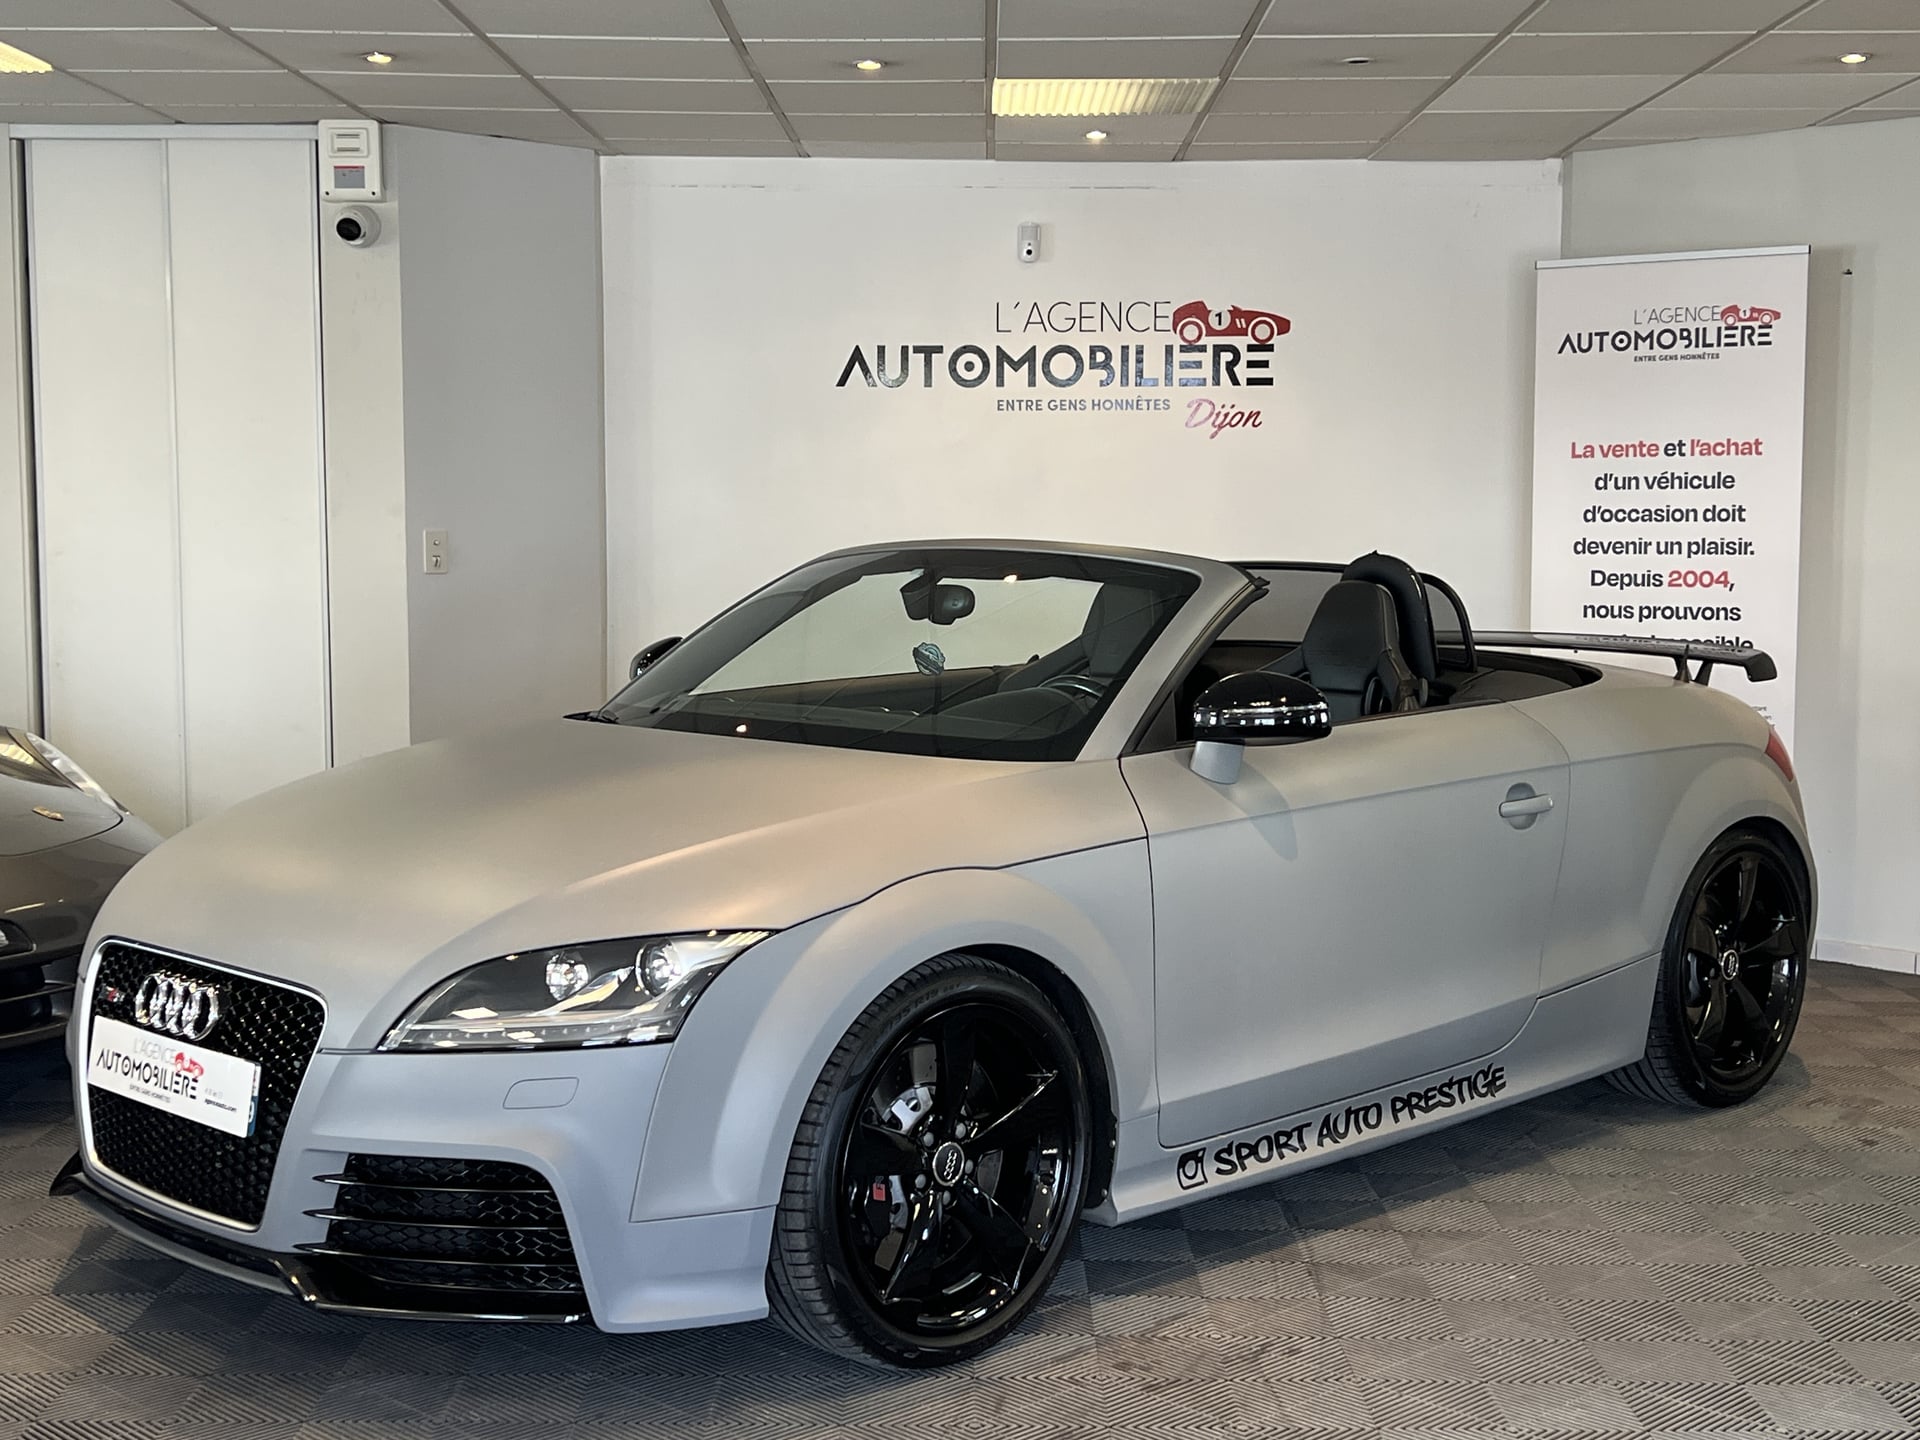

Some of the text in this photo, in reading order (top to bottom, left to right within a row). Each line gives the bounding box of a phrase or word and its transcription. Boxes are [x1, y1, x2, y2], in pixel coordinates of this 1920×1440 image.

[997, 395, 1171, 412] ENTRE GENS HONNÊTES
[1185, 398, 1262, 439] Dijon
[1570, 438, 1763, 459] La vente et l'achat
[1594, 471, 1735, 490] d'un véhicule
[1582, 504, 1746, 523] d'occasion doit
[1573, 537, 1755, 559] devenir un plaisir.
[1590, 569, 1735, 592] Depuis 2004,
[1582, 603, 1742, 623] nous prouvons
[1213, 1063, 1506, 1176] SPORT AUTO PRESTIGE
